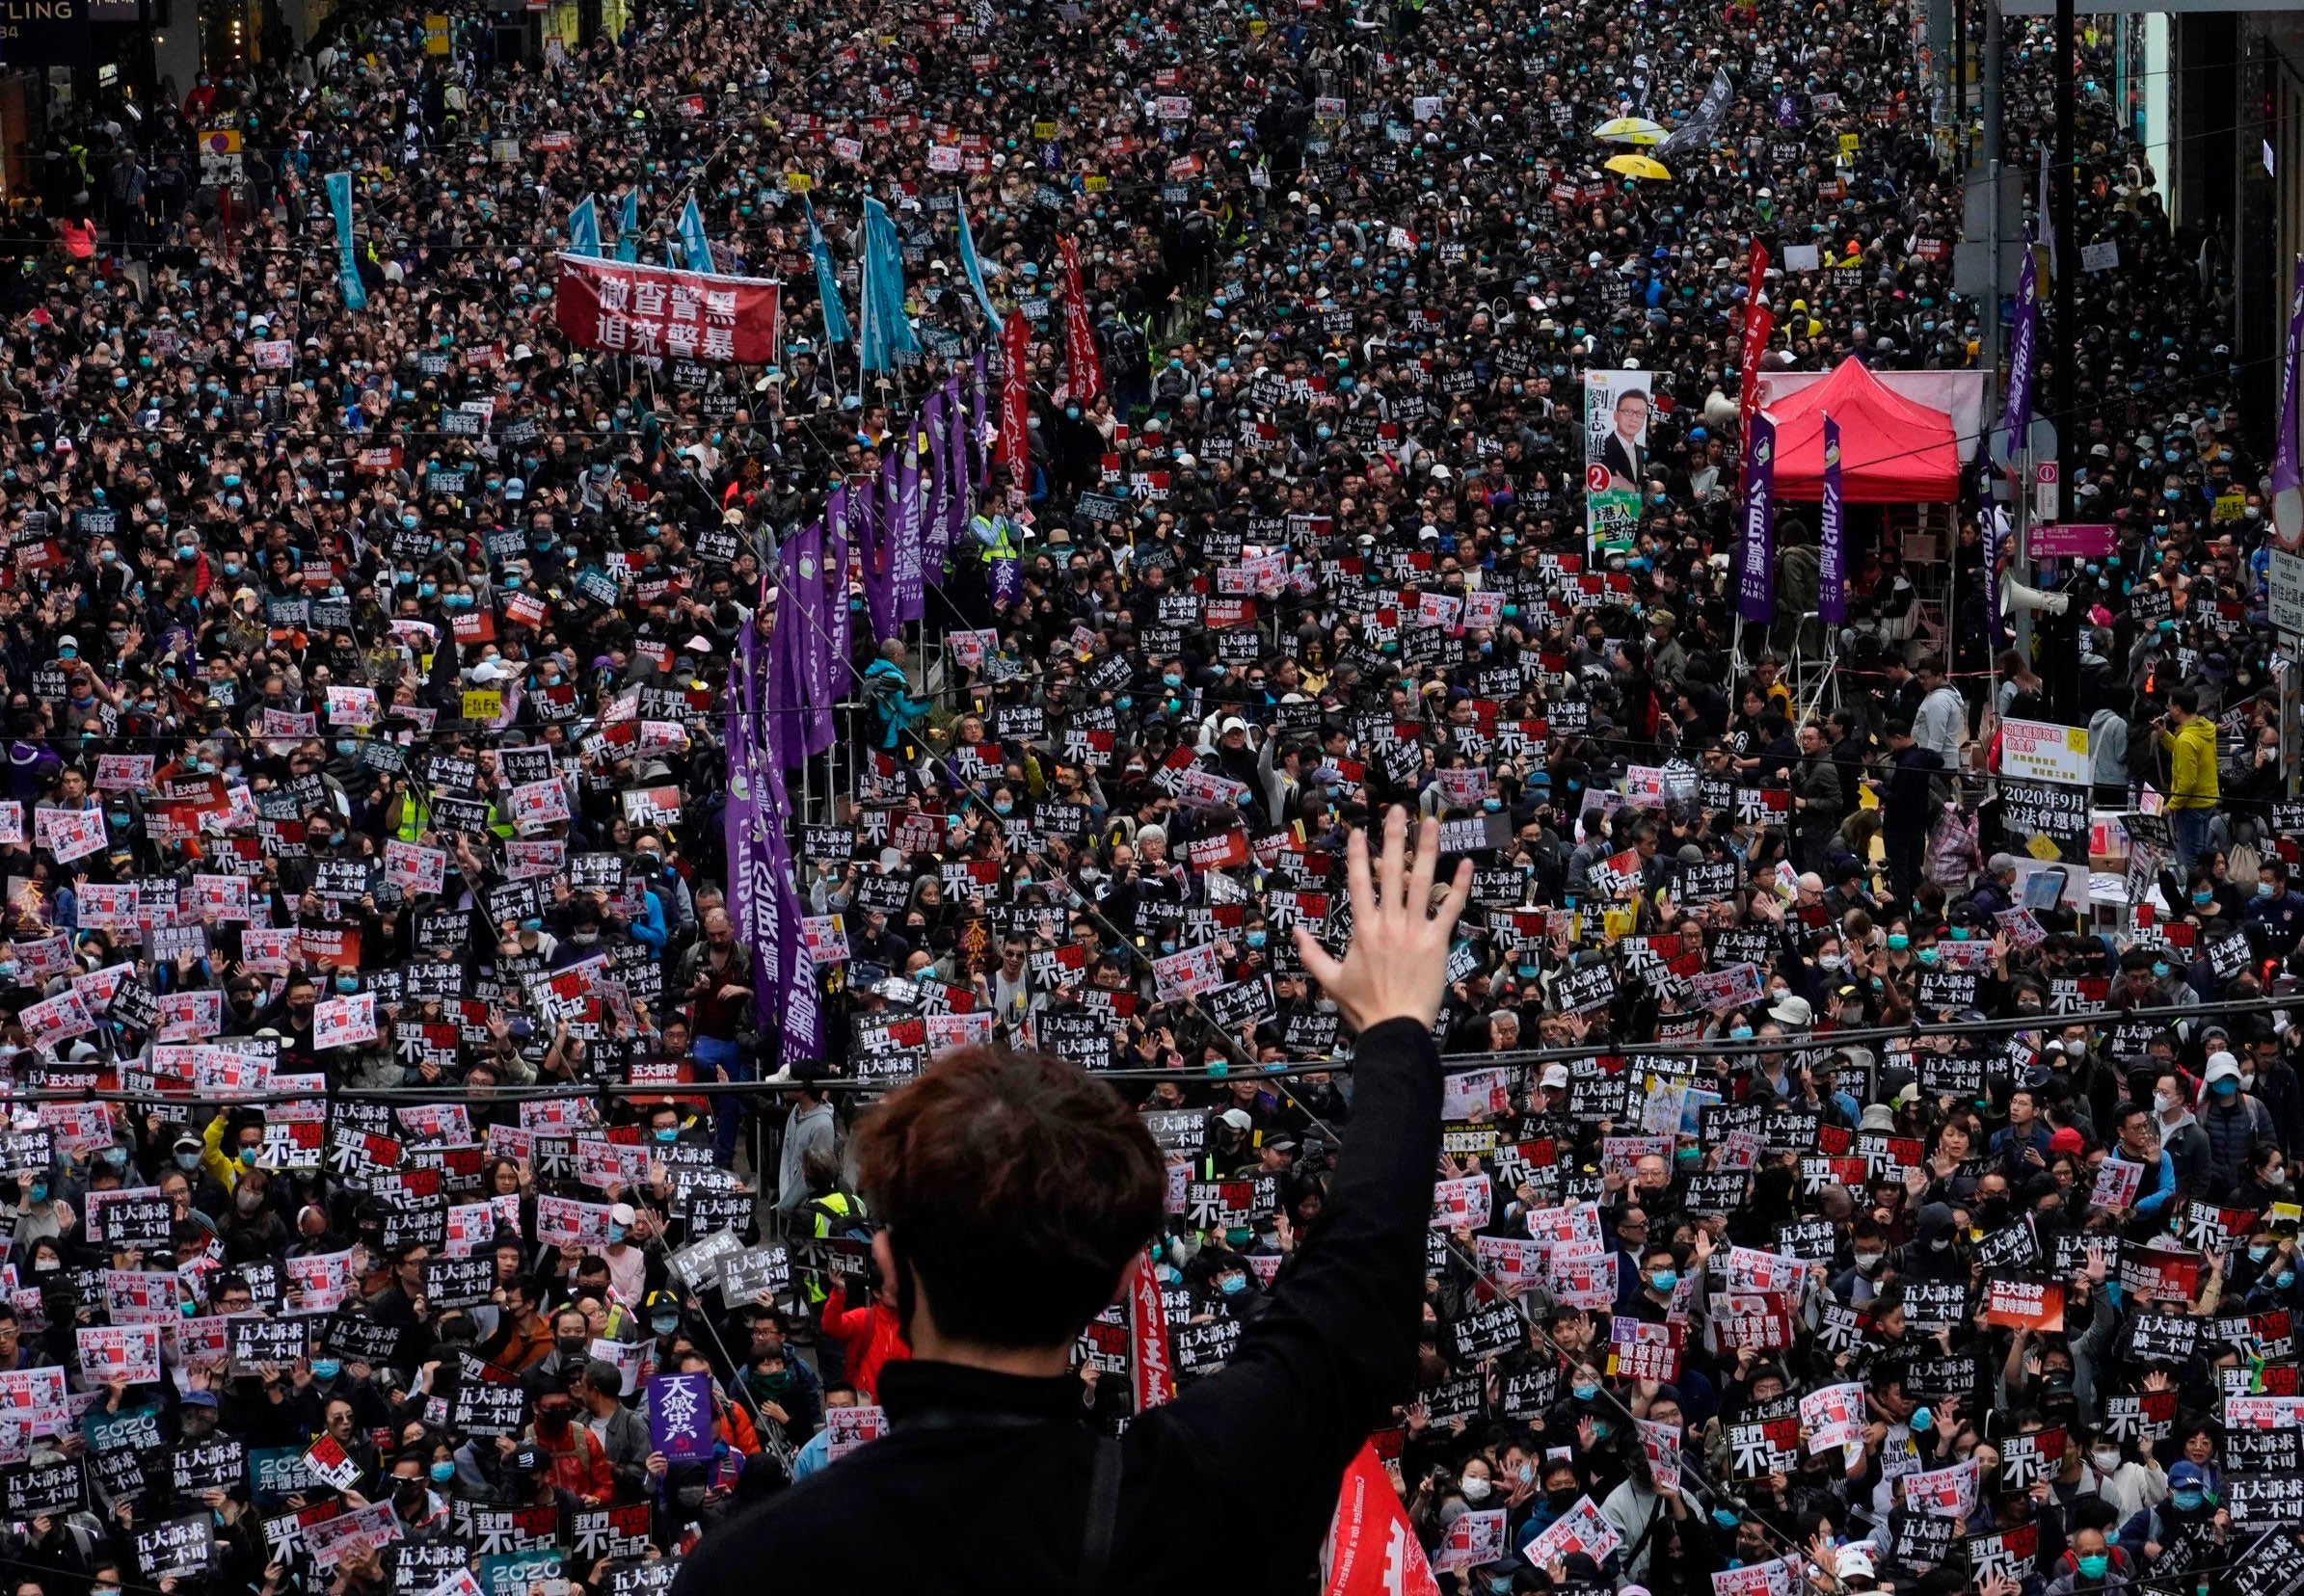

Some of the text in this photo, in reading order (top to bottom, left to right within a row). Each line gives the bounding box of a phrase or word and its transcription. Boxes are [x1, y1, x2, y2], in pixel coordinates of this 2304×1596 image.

[0, 2, 72, 19] LING
[598, 277, 737, 326] 徹查警黑
[595, 315, 736, 362] 追究警暴
[445, 414, 482, 425] 2020
[1589, 389, 1609, 456] 劉志雄
[430, 472, 465, 483] 2020
[1591, 467, 1603, 490] 2
[80, 514, 115, 523] 2020
[489, 535, 524, 545] 2020
[1604, 520, 1639, 543] 堅持
[589, 572, 619, 592] 2020
[314, 606, 350, 616] 2020
[1158, 596, 1197, 608] 五大訴求
[1478, 668, 1520, 681] 五大訴求
[999, 708, 1043, 722] 五大訴求
[998, 721, 1043, 733] 缺一不可
[367, 742, 402, 759] 2020
[430, 757, 476, 774] 五大訴求
[507, 757, 546, 770] 五大訴求
[1738, 789, 1760, 804] 我們
[2004, 785, 2085, 811] 2020年9月
[2006, 806, 2086, 831] 立法會選舉
[805, 829, 853, 844] 五大訴求
[804, 843, 852, 858] 缺一不可
[317, 863, 366, 876] 五大訴求
[571, 855, 622, 869] 五大訴求
[942, 864, 967, 878] 我們
[570, 869, 622, 886] 缺一不可
[1470, 873, 1523, 886] 五大訴求
[1686, 863, 1737, 880] 五大訴求
[1685, 879, 1735, 895] 缺一不可
[1271, 892, 1295, 906] 我們
[407, 962, 462, 977] 五大訴求
[1029, 953, 1055, 971] 我們
[406, 978, 461, 994] 缺一不可
[2050, 981, 2077, 994] 我們
[395, 1022, 422, 1038] 我們
[1042, 1016, 1094, 1032] 五大訴求
[1288, 1018, 1338, 1033] 五大訴求
[1056, 1040, 1110, 1055] 五大訴求
[631, 1064, 678, 1077] 五大訴求
[858, 1058, 913, 1075] 五大訴求
[1923, 1057, 1981, 1075] 五大訴求
[1572, 1080, 1625, 1098] 五大訴求
[1570, 1097, 1624, 1111] 缺一不可
[264, 1127, 288, 1144] 我們
[335, 1130, 363, 1149] 我們
[1858, 1135, 1887, 1153] 我們
[0, 1134, 50, 1156] 大訴求
[1494, 1146, 1517, 1163] 我們
[1801, 1158, 1830, 1174] 我們
[1191, 1184, 1219, 1200] 我們
[1688, 1176, 1744, 1191] 五大訴求
[694, 1199, 752, 1216] 五大訴求
[1685, 1191, 1742, 1208] 缺一不可
[110, 1203, 171, 1220] 五大訴求
[2190, 1207, 2219, 1225] 我們
[109, 1219, 171, 1237] 缺一不可
[726, 1248, 788, 1271] 五大訴求
[427, 1264, 492, 1282] 五大訴求
[727, 1264, 790, 1288] 缺一不可
[426, 1278, 492, 1299] 缺一不可
[1903, 1285, 1964, 1303] 五大訴求
[1992, 1279, 2045, 1297] 五大訴求
[1903, 1302, 1964, 1318] 缺一不可
[1992, 1297, 2043, 1317] 堅持到底
[1452, 1306, 1517, 1337] 五大訴求
[2136, 1313, 2197, 1337] 五大訴求
[236, 1323, 303, 1342] 五大訴求
[1178, 1317, 1242, 1349] 五大訴求
[2132, 1332, 2194, 1355] 缺一不可
[1620, 1342, 1676, 1365] 徹查警黑
[1506, 1367, 1557, 1394] 五大訴求
[458, 1387, 524, 1406] 五大訴求
[1417, 1377, 1481, 1404] 五大訴求
[1505, 1386, 1556, 1410] 缺一不可
[455, 1405, 522, 1425] 缺一不可
[659, 1375, 699, 1442] 天滅中共
[2107, 1397, 2139, 1415] 我們
[94, 1417, 156, 1441] 2020
[1728, 1423, 1762, 1444] 我們
[1889, 1438, 1910, 1451] NEW
[2003, 1436, 2035, 1456] 我們
[2226, 1437, 2295, 1452] 五大訴求
[172, 1442, 242, 1470] 五大訴求
[2226, 1452, 2295, 1471] 缺一不可
[173, 1460, 242, 1489] 缺一不可
[259, 1459, 307, 1474] 202
[8, 1470, 78, 1492] 五大訴求
[2230, 1478, 2303, 1500] 五大訴求
[2230, 1499, 2303, 1520] 缺一不可
[476, 1511, 512, 1531] 我們
[575, 1510, 609, 1530] 我們
[137, 1523, 205, 1556] 五大訴求
[1903, 1522, 1952, 1542] 五大訴求
[397, 1545, 466, 1566] 五大訴求
[1969, 1537, 2002, 1556] 我們
[138, 1542, 208, 1572] 缺一不可
[492, 1559, 561, 1582] 2020
